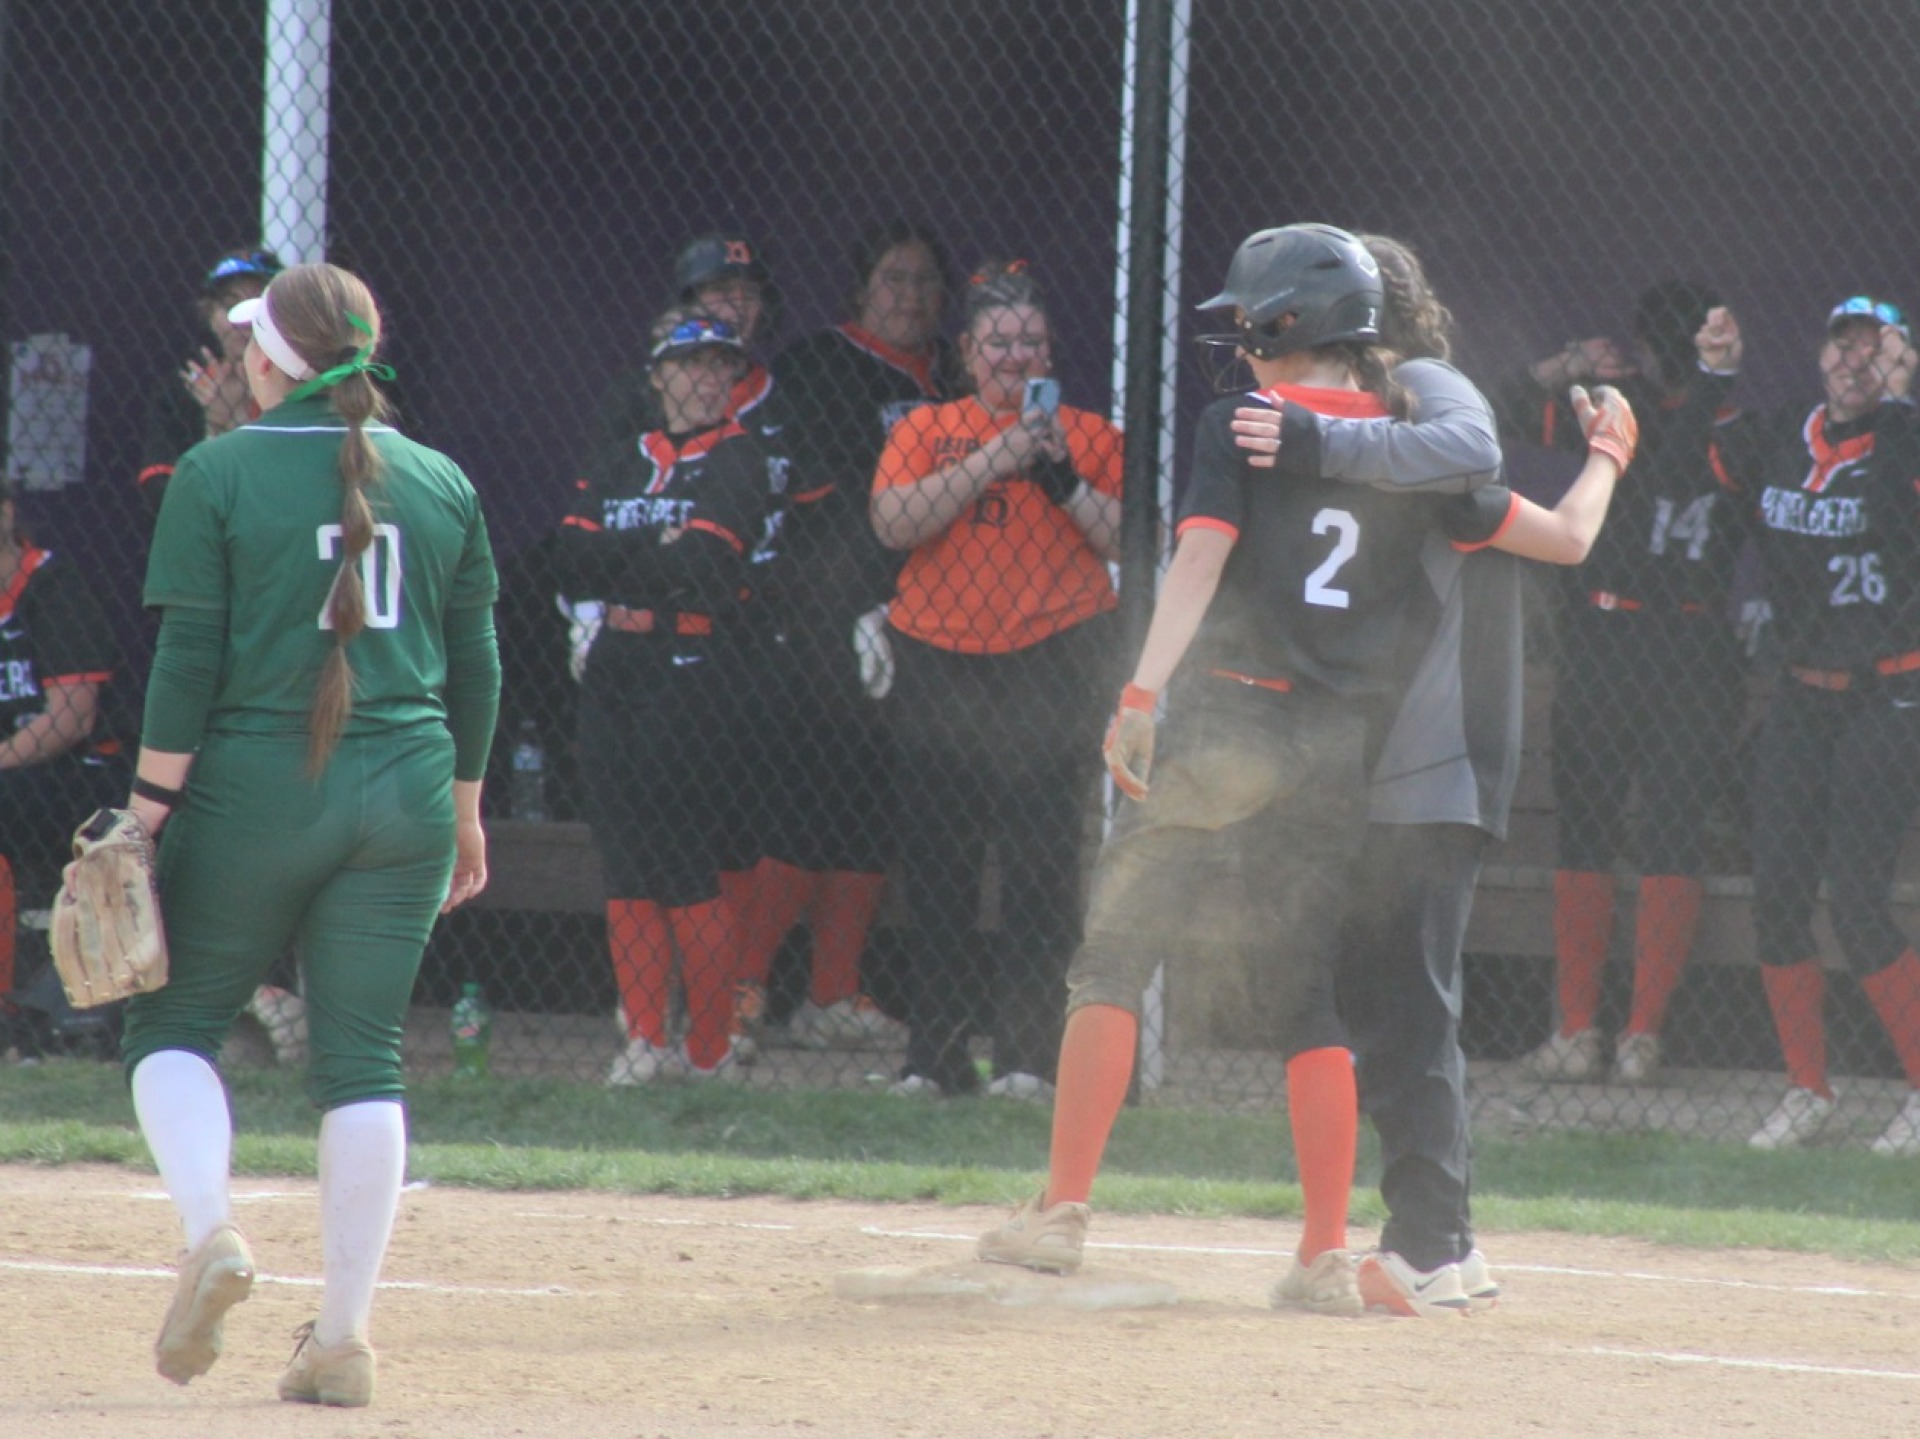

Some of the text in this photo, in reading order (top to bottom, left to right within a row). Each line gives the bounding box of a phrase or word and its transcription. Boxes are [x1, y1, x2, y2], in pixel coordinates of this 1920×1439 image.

[1305, 508, 1359, 608] 2
[1649, 493, 1716, 560] 14
[1827, 552, 1886, 606] 26
